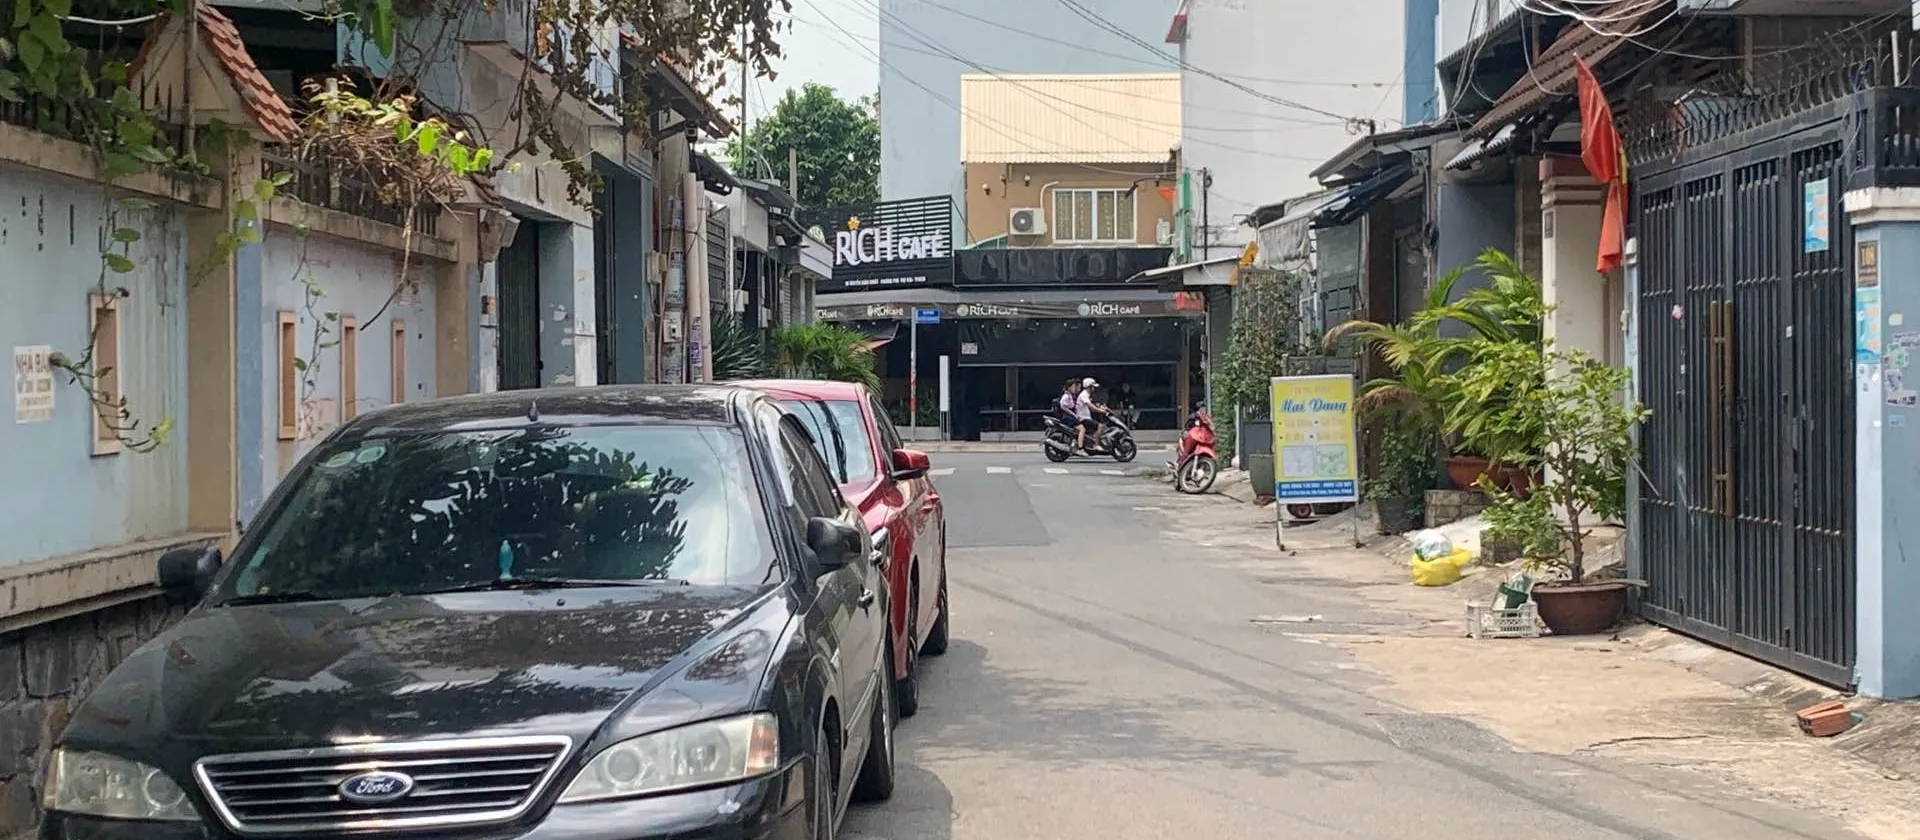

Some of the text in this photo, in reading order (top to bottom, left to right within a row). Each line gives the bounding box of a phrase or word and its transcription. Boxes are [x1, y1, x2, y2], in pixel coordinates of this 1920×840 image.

[836, 227, 944, 266] RICH CAFÉ
[969, 303, 997, 315] RICH
[1091, 302, 1118, 315] RICH
[356, 776, 396, 793] Ford
